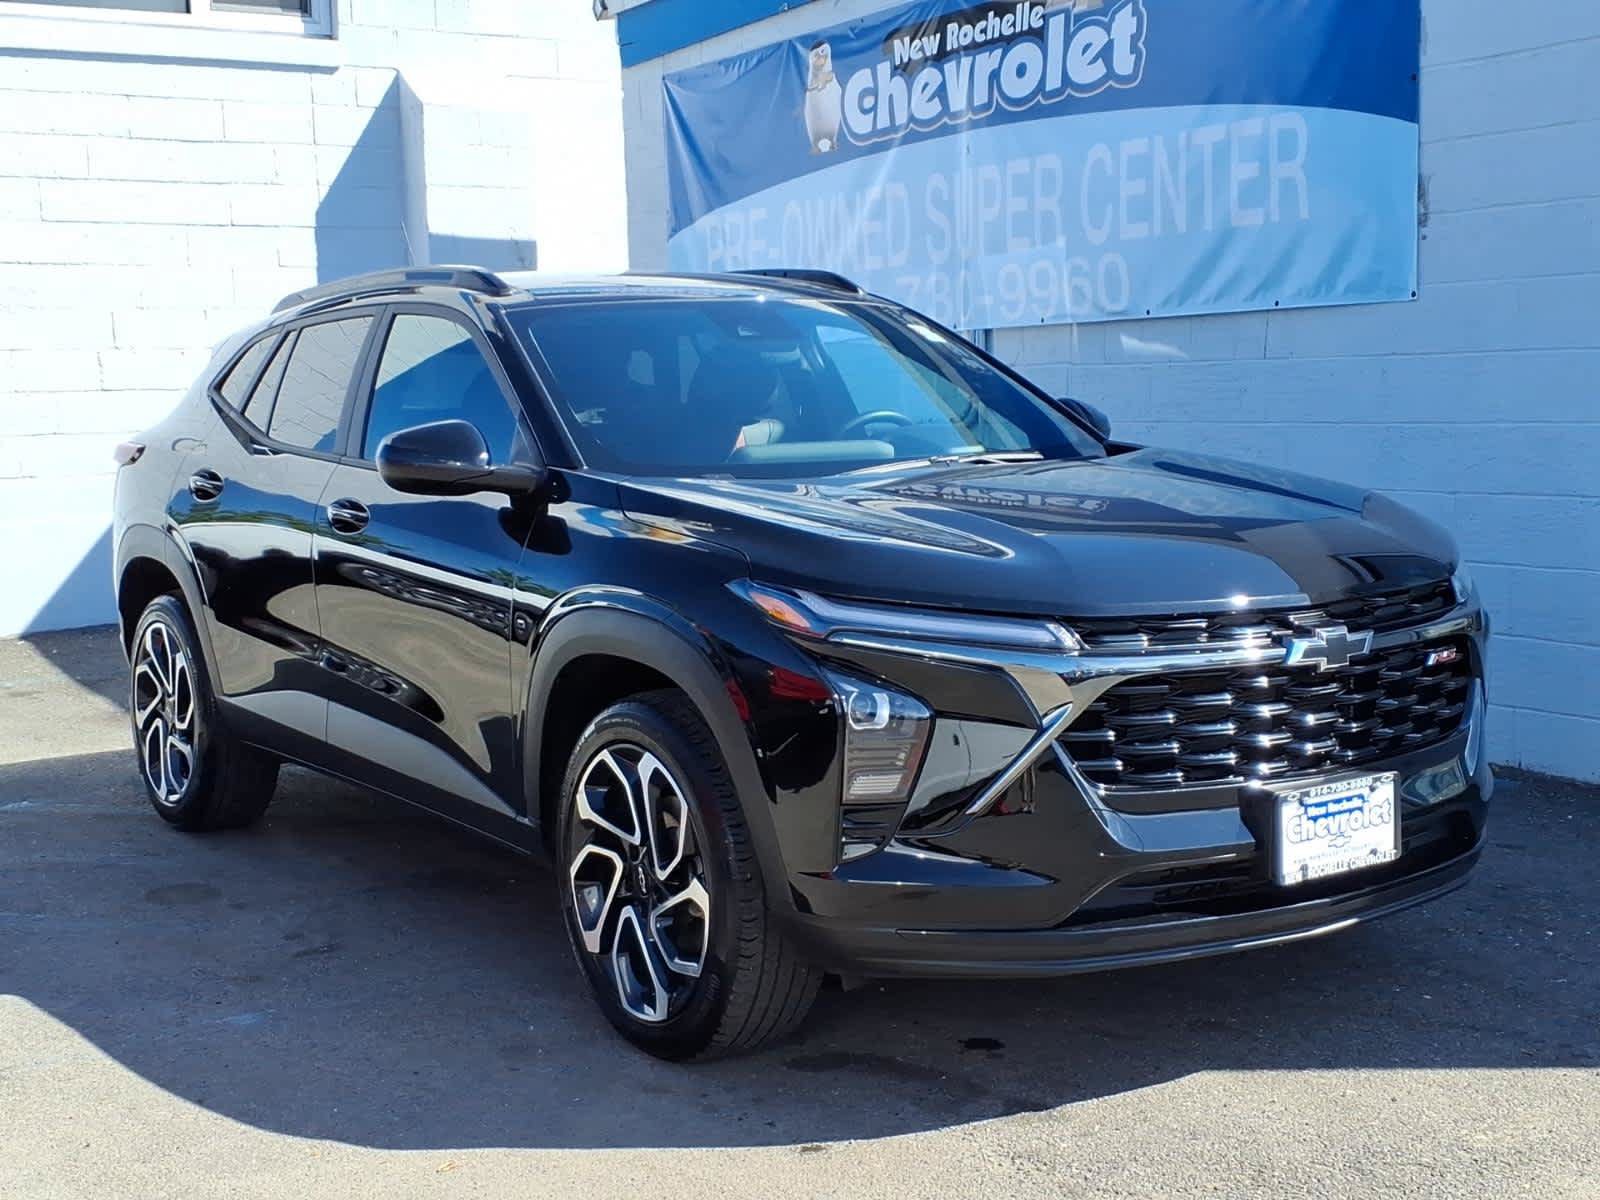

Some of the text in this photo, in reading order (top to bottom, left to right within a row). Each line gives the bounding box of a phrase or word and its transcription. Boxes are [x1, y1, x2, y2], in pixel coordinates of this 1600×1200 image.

[893, 2, 1045, 66] New Rochelle
[925, 153, 1064, 267] SUPER
[1081, 112, 1310, 246] CENTER
[1287, 799, 1391, 843] Chevrolet
